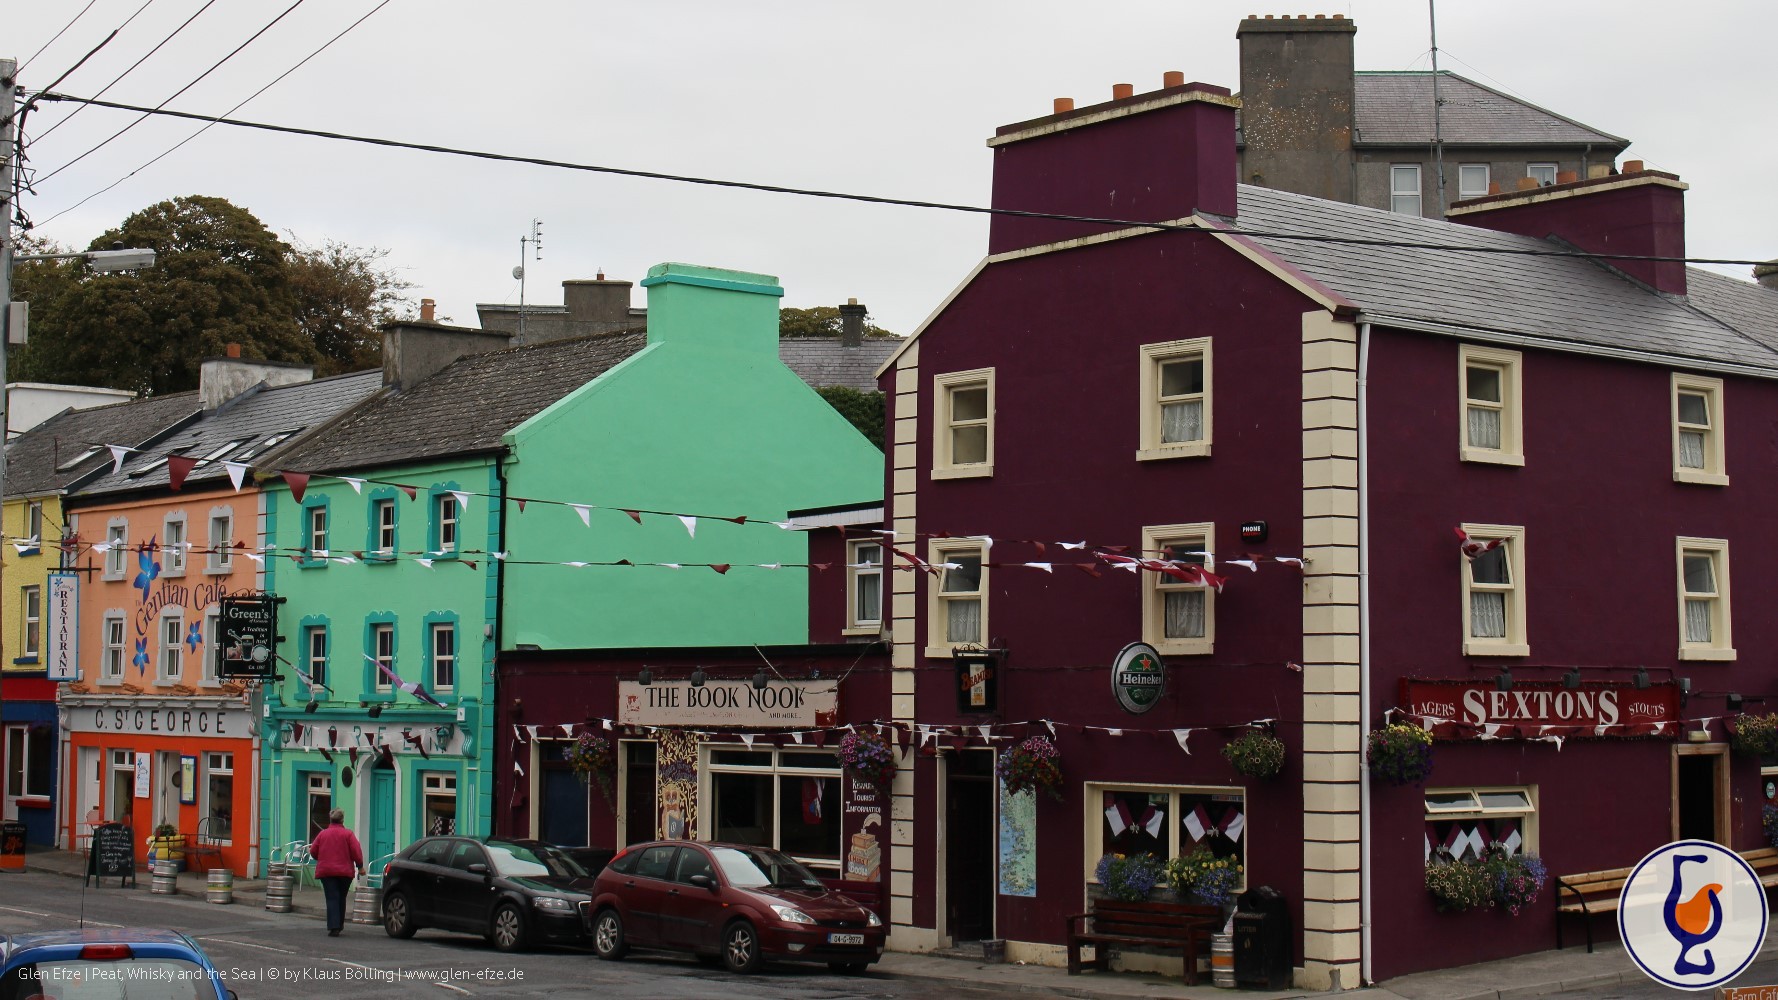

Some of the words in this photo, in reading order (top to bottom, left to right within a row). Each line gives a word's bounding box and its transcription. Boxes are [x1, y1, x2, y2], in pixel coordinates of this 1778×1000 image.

[135, 579, 189, 636] Gentian
[194, 575, 228, 611] Café
[229, 607, 269, 619] Green's
[59, 590, 68, 677] RESTAURANT
[645, 687, 680, 708] THE
[687, 687, 740, 708] BOOK
[743, 683, 806, 712] NOOK
[1411, 701, 1456, 717] LAGERS
[1463, 689, 1620, 726] SEXTONS
[1628, 702, 1666, 714] STOUTS
[95, 709, 108, 730] C.
[134, 709, 226, 734] GEORGE
[852, 790, 876, 801] TOURIST
[1760, 988, 1778, 1000] Caf
